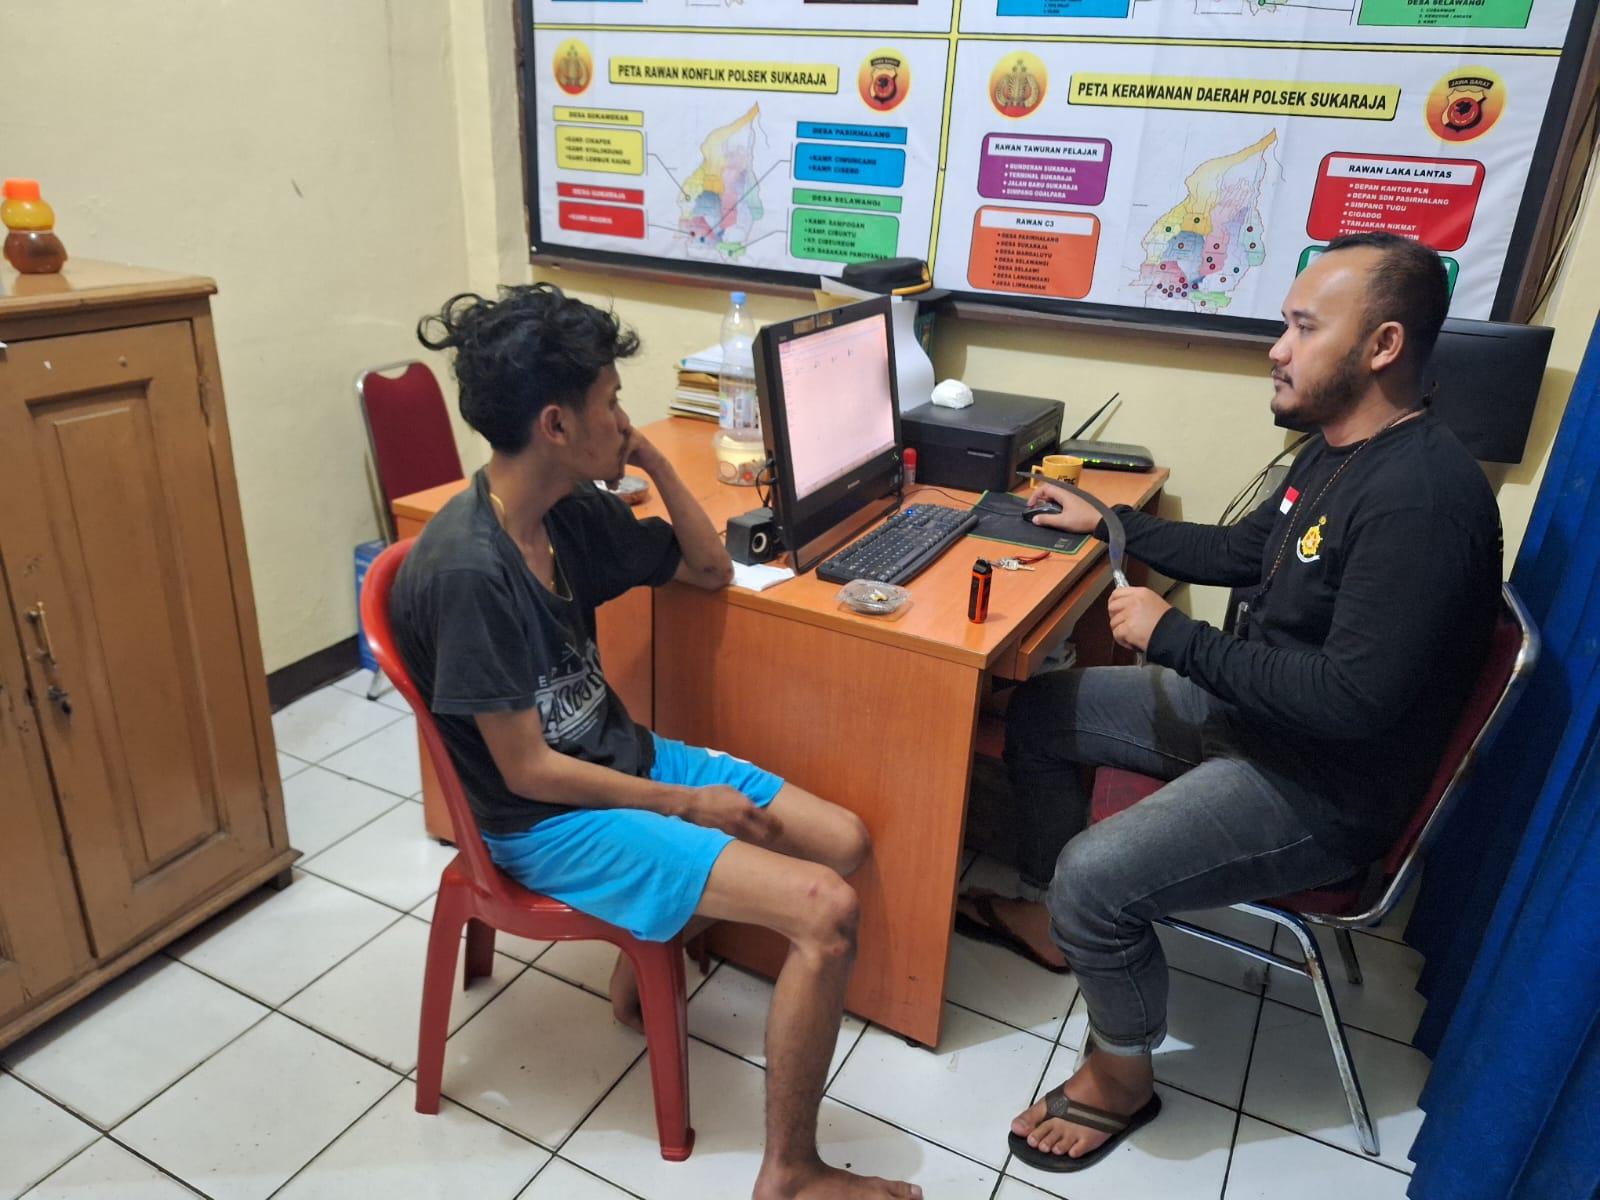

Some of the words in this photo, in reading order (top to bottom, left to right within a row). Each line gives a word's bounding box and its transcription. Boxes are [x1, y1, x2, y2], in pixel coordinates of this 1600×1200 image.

[618, 64, 642, 78] PETA
[644, 66, 680, 79] RAWAN
[682, 67, 725, 81] KONFLIK
[728, 69, 767, 83] POLSEK
[771, 70, 828, 86] SUKARAJA
[1078, 83, 1109, 97] PETA
[1112, 84, 1192, 101] KERAWANAN
[1196, 87, 1249, 104] DAERAH
[1252, 89, 1306, 107] POLSEK
[1310, 92, 1387, 110] SUKARAJA
[994, 144, 1021, 152] RAWAN
[1024, 145, 1060, 154] TAWURAN
[1062, 147, 1097, 156] PELAJAR
[1348, 165, 1383, 174] RAWAN
[1385, 167, 1410, 176] LAKA
[1414, 169, 1452, 178] LANTAS
[1040, 173, 1072, 182] SUKARAJA
[1380, 185, 1412, 194] KANTOR
[835, 196, 880, 206] SELAWANGI
[1352, 192, 1377, 201] DEPAN
[1395, 196, 1449, 205] PASIRHALANG
[1350, 202, 1383, 210] SIMPANG
[1346, 220, 1385, 229] TANJAKAN
[1387, 222, 1416, 231] NIKMAT
